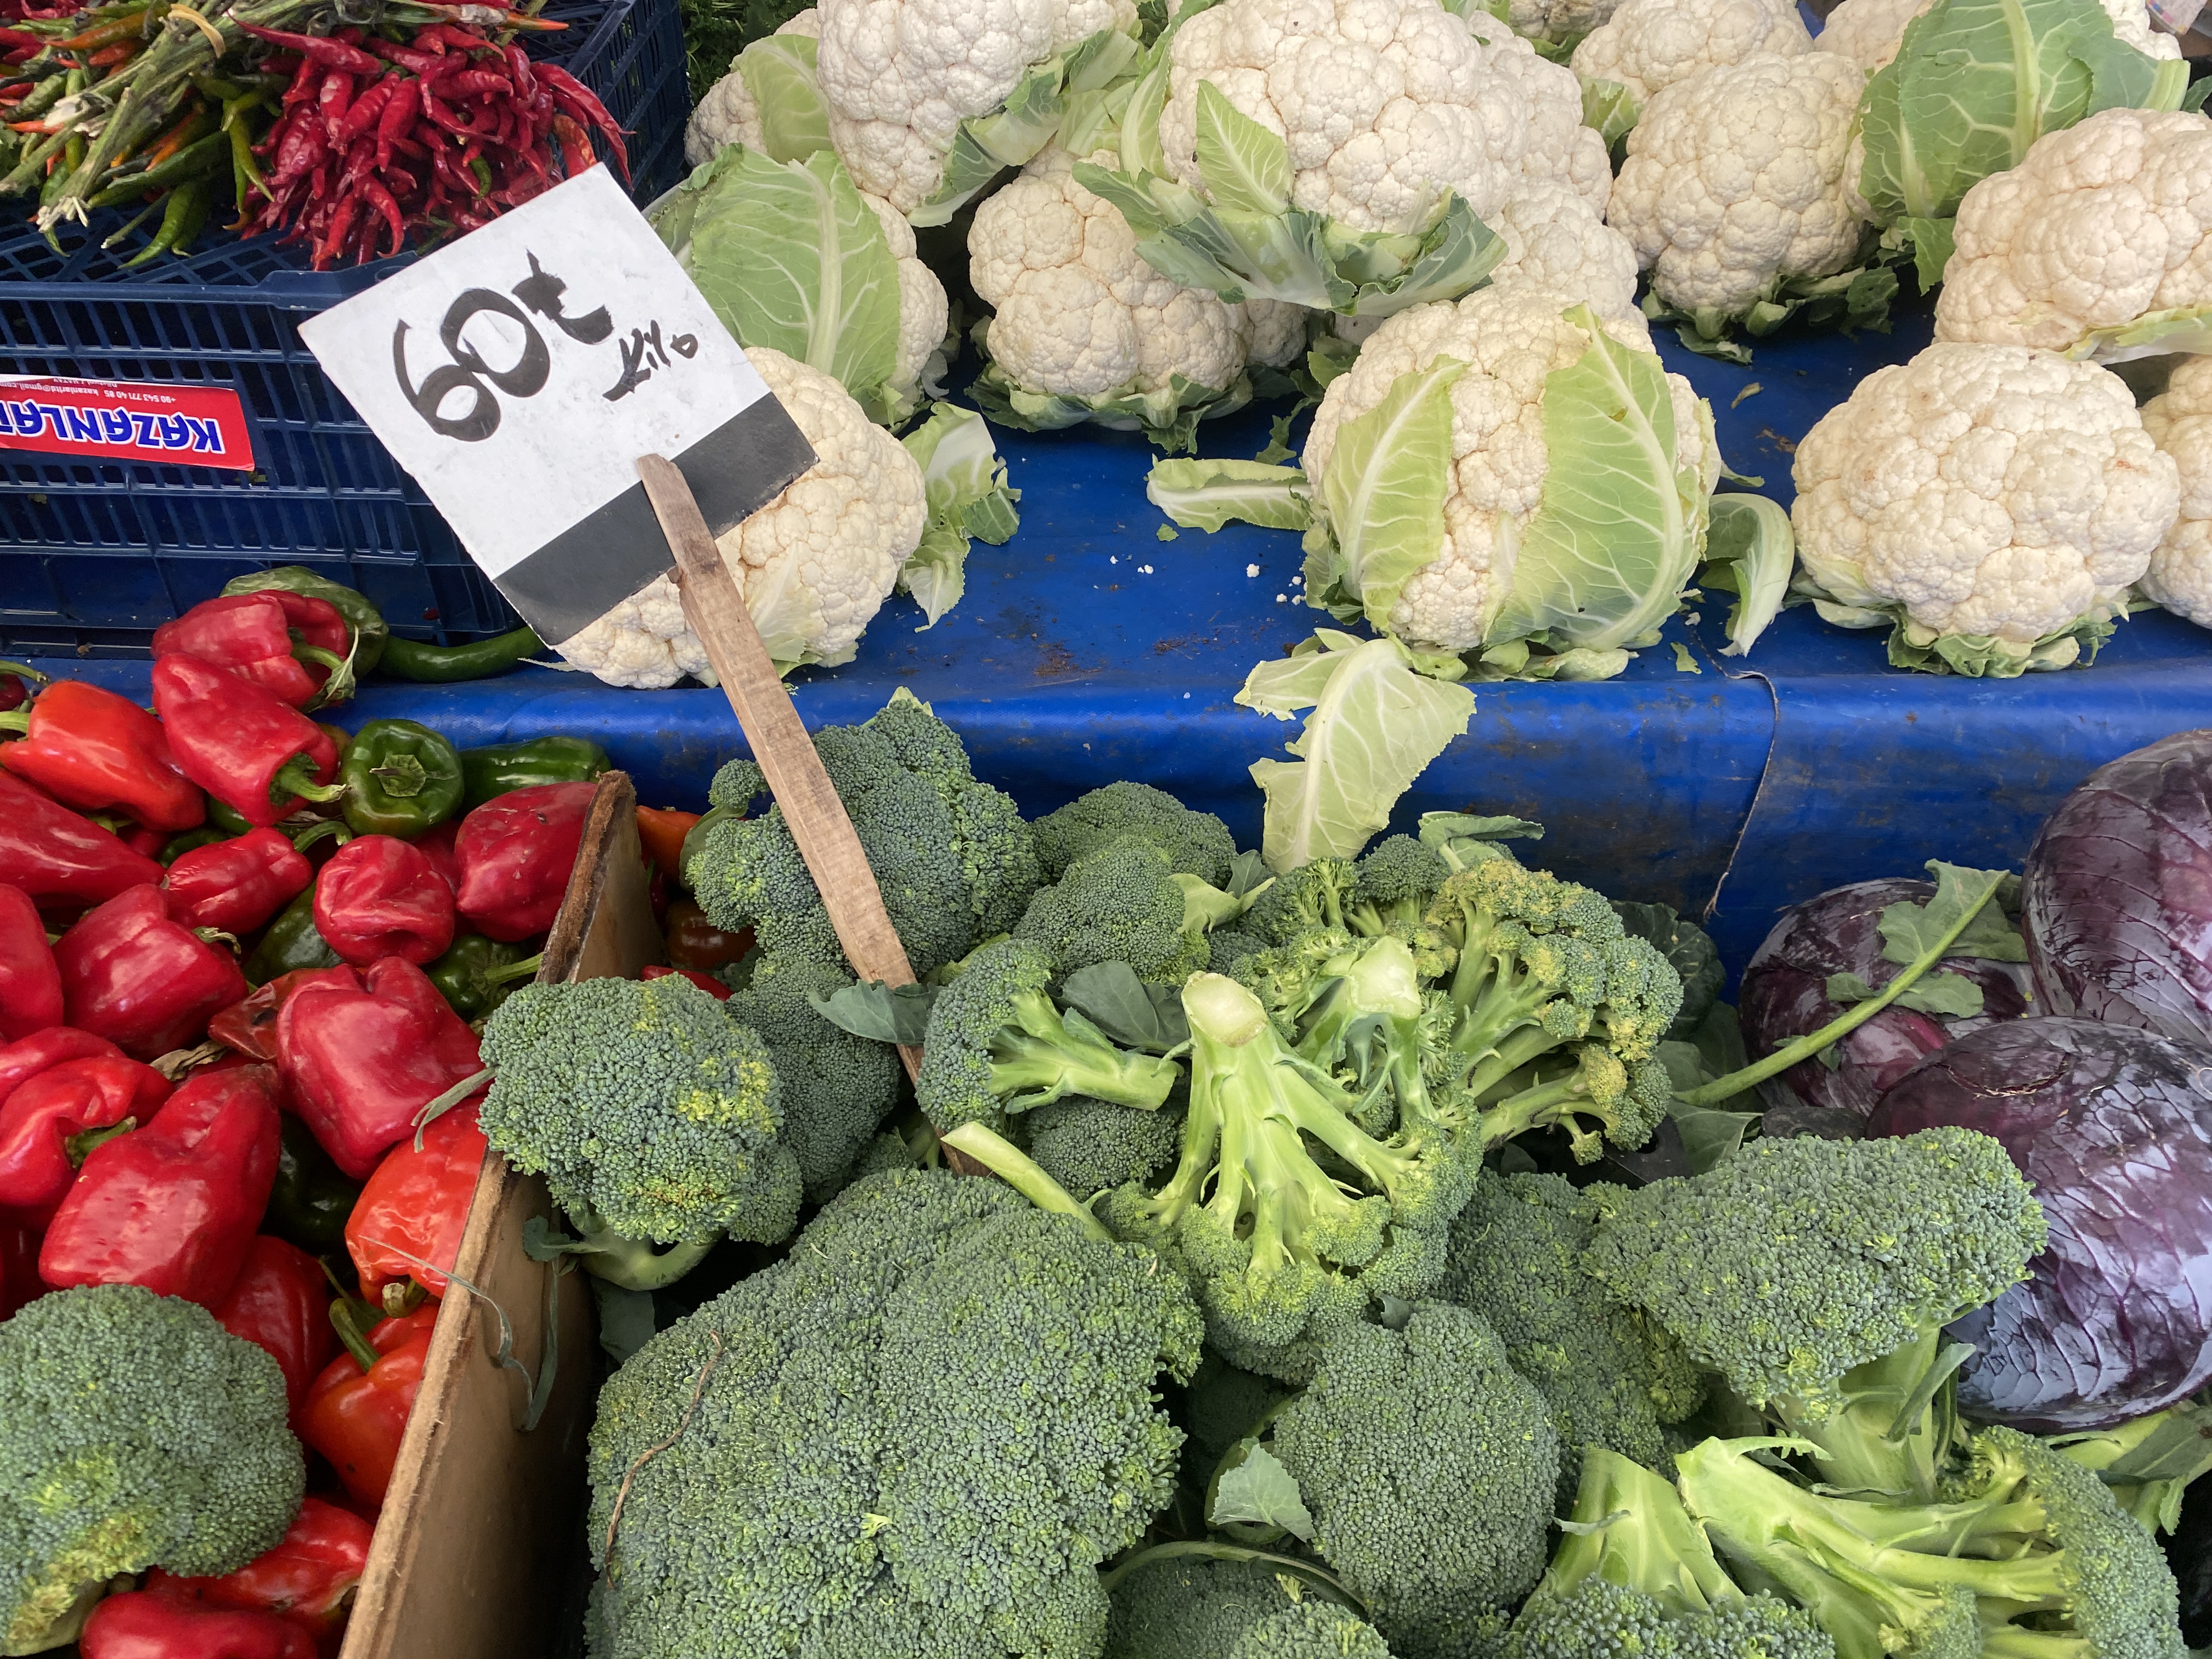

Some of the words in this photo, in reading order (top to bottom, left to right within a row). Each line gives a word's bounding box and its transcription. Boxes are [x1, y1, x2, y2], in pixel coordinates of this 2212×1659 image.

[104, 390, 115, 398] 85
[116, 391, 127, 399] 40
[128, 392, 142, 401] 771
[143, 393, 159, 402] 543
